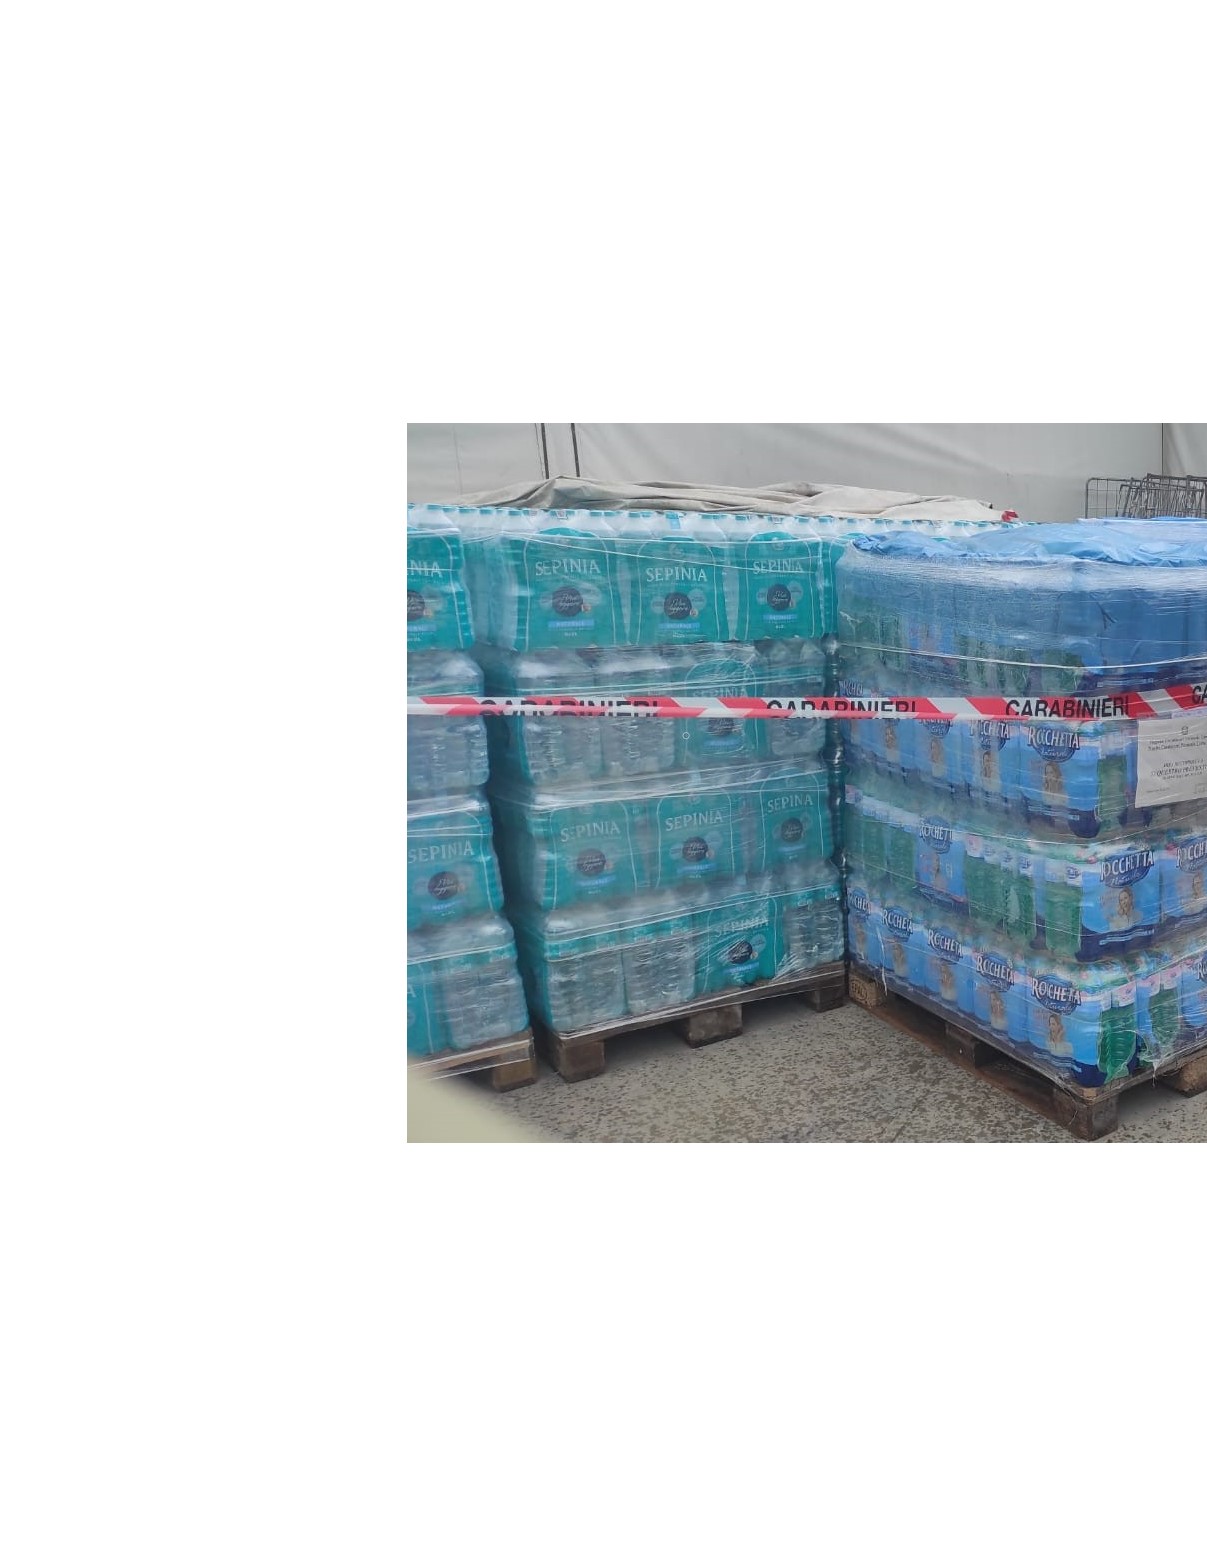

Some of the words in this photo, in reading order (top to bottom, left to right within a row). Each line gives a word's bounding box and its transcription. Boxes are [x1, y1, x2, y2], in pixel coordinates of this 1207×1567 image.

[535, 558, 601, 577] SEPINIA
[646, 566, 708, 583] SEPINIA
[753, 558, 804, 575] SEPINIA
[1005, 695, 1129, 718] CARABINIERI
[665, 810, 724, 832] SEPINIA
[408, 840, 476, 864] SEPINIA
